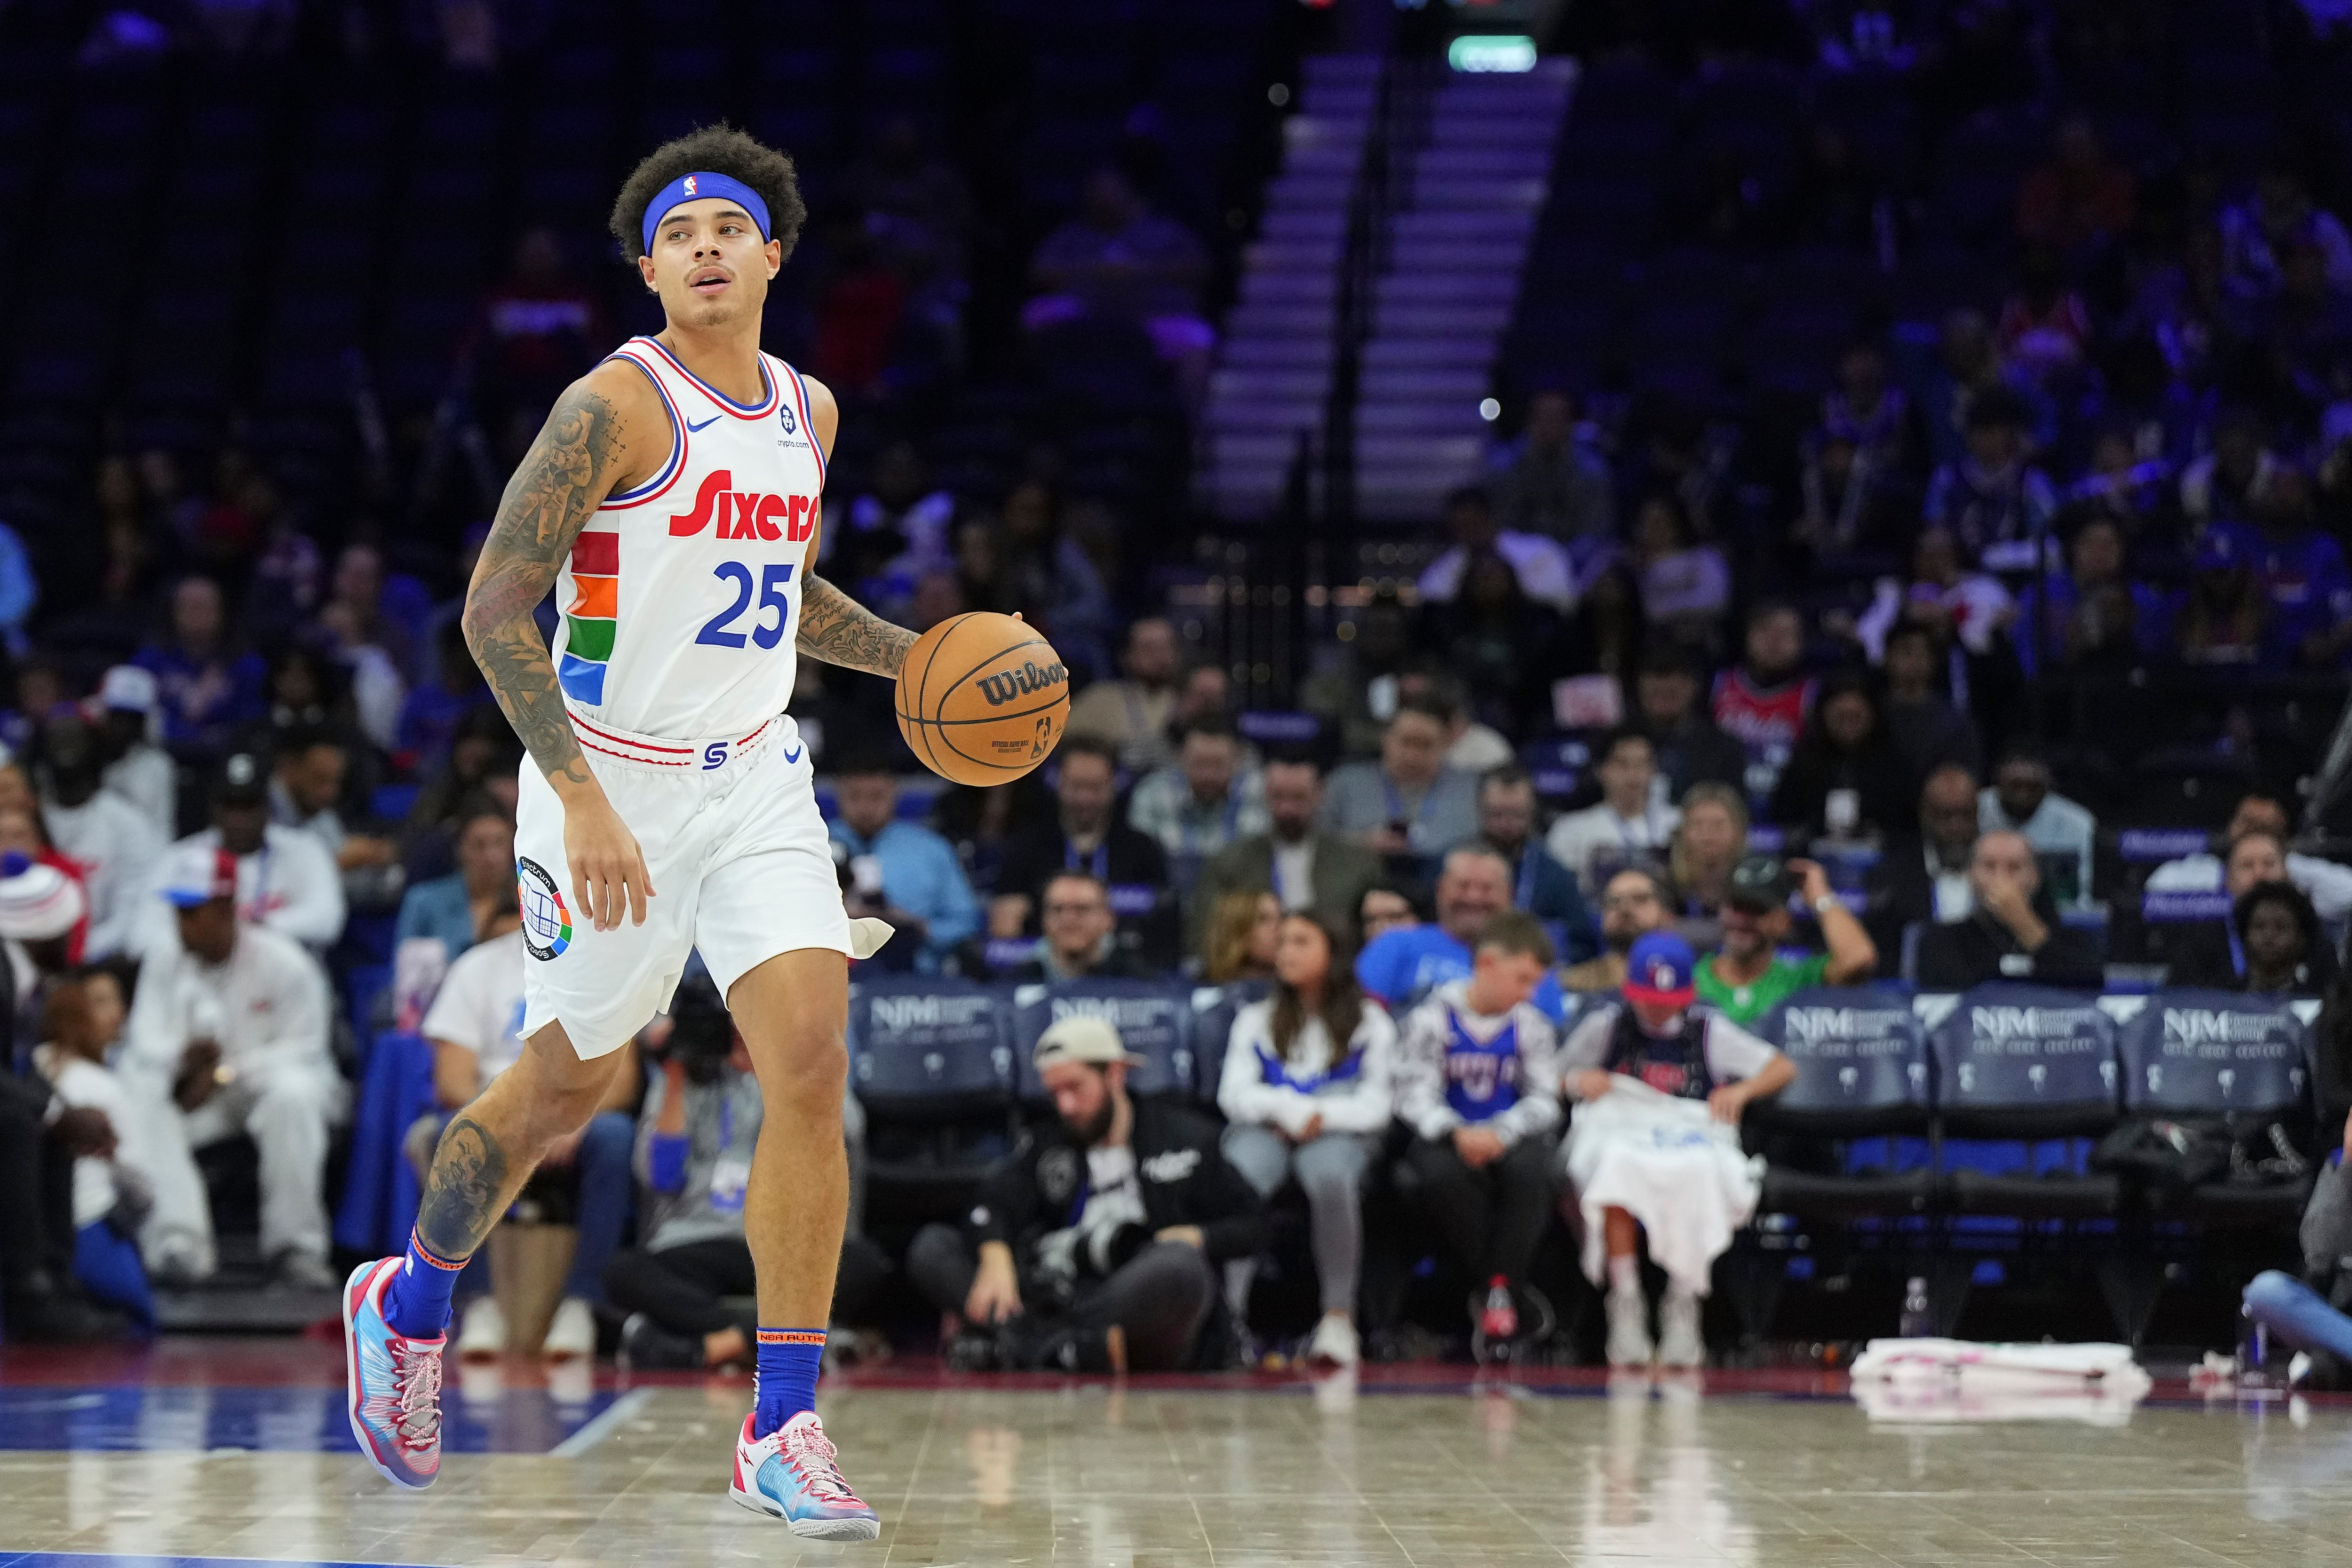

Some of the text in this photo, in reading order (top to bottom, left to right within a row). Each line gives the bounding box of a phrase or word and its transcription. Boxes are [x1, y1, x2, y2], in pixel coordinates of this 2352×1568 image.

[778, 440, 809, 448] crypto.com
[668, 470, 818, 542] Sixers
[694, 561, 794, 649] 25
[976, 660, 1067, 706] Wilson
[1786, 1006, 1852, 1047] NJM
[1972, 1006, 2036, 1045] NJM
[2164, 1007, 2228, 1048] NJM
